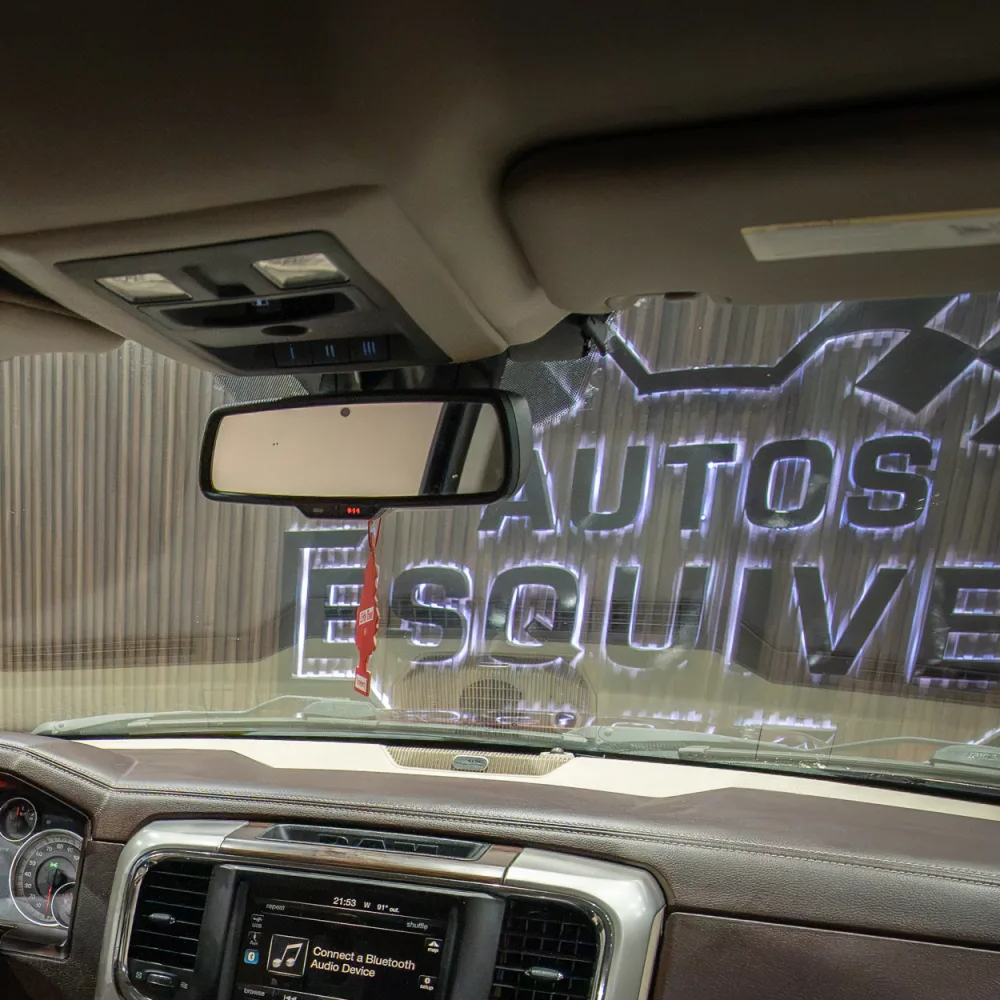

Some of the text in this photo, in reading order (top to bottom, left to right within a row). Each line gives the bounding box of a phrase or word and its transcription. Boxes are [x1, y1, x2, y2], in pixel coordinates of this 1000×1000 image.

[477, 435, 930, 532] AUTOS
[332, 896, 357, 907] 21:53
[363, 901, 371, 909] W
[406, 921, 429, 931] shuffle
[312, 946, 416, 971] Connect a Bluetooth
[310, 959, 376, 978] Audio Device
[243, 988, 266, 997] browse
